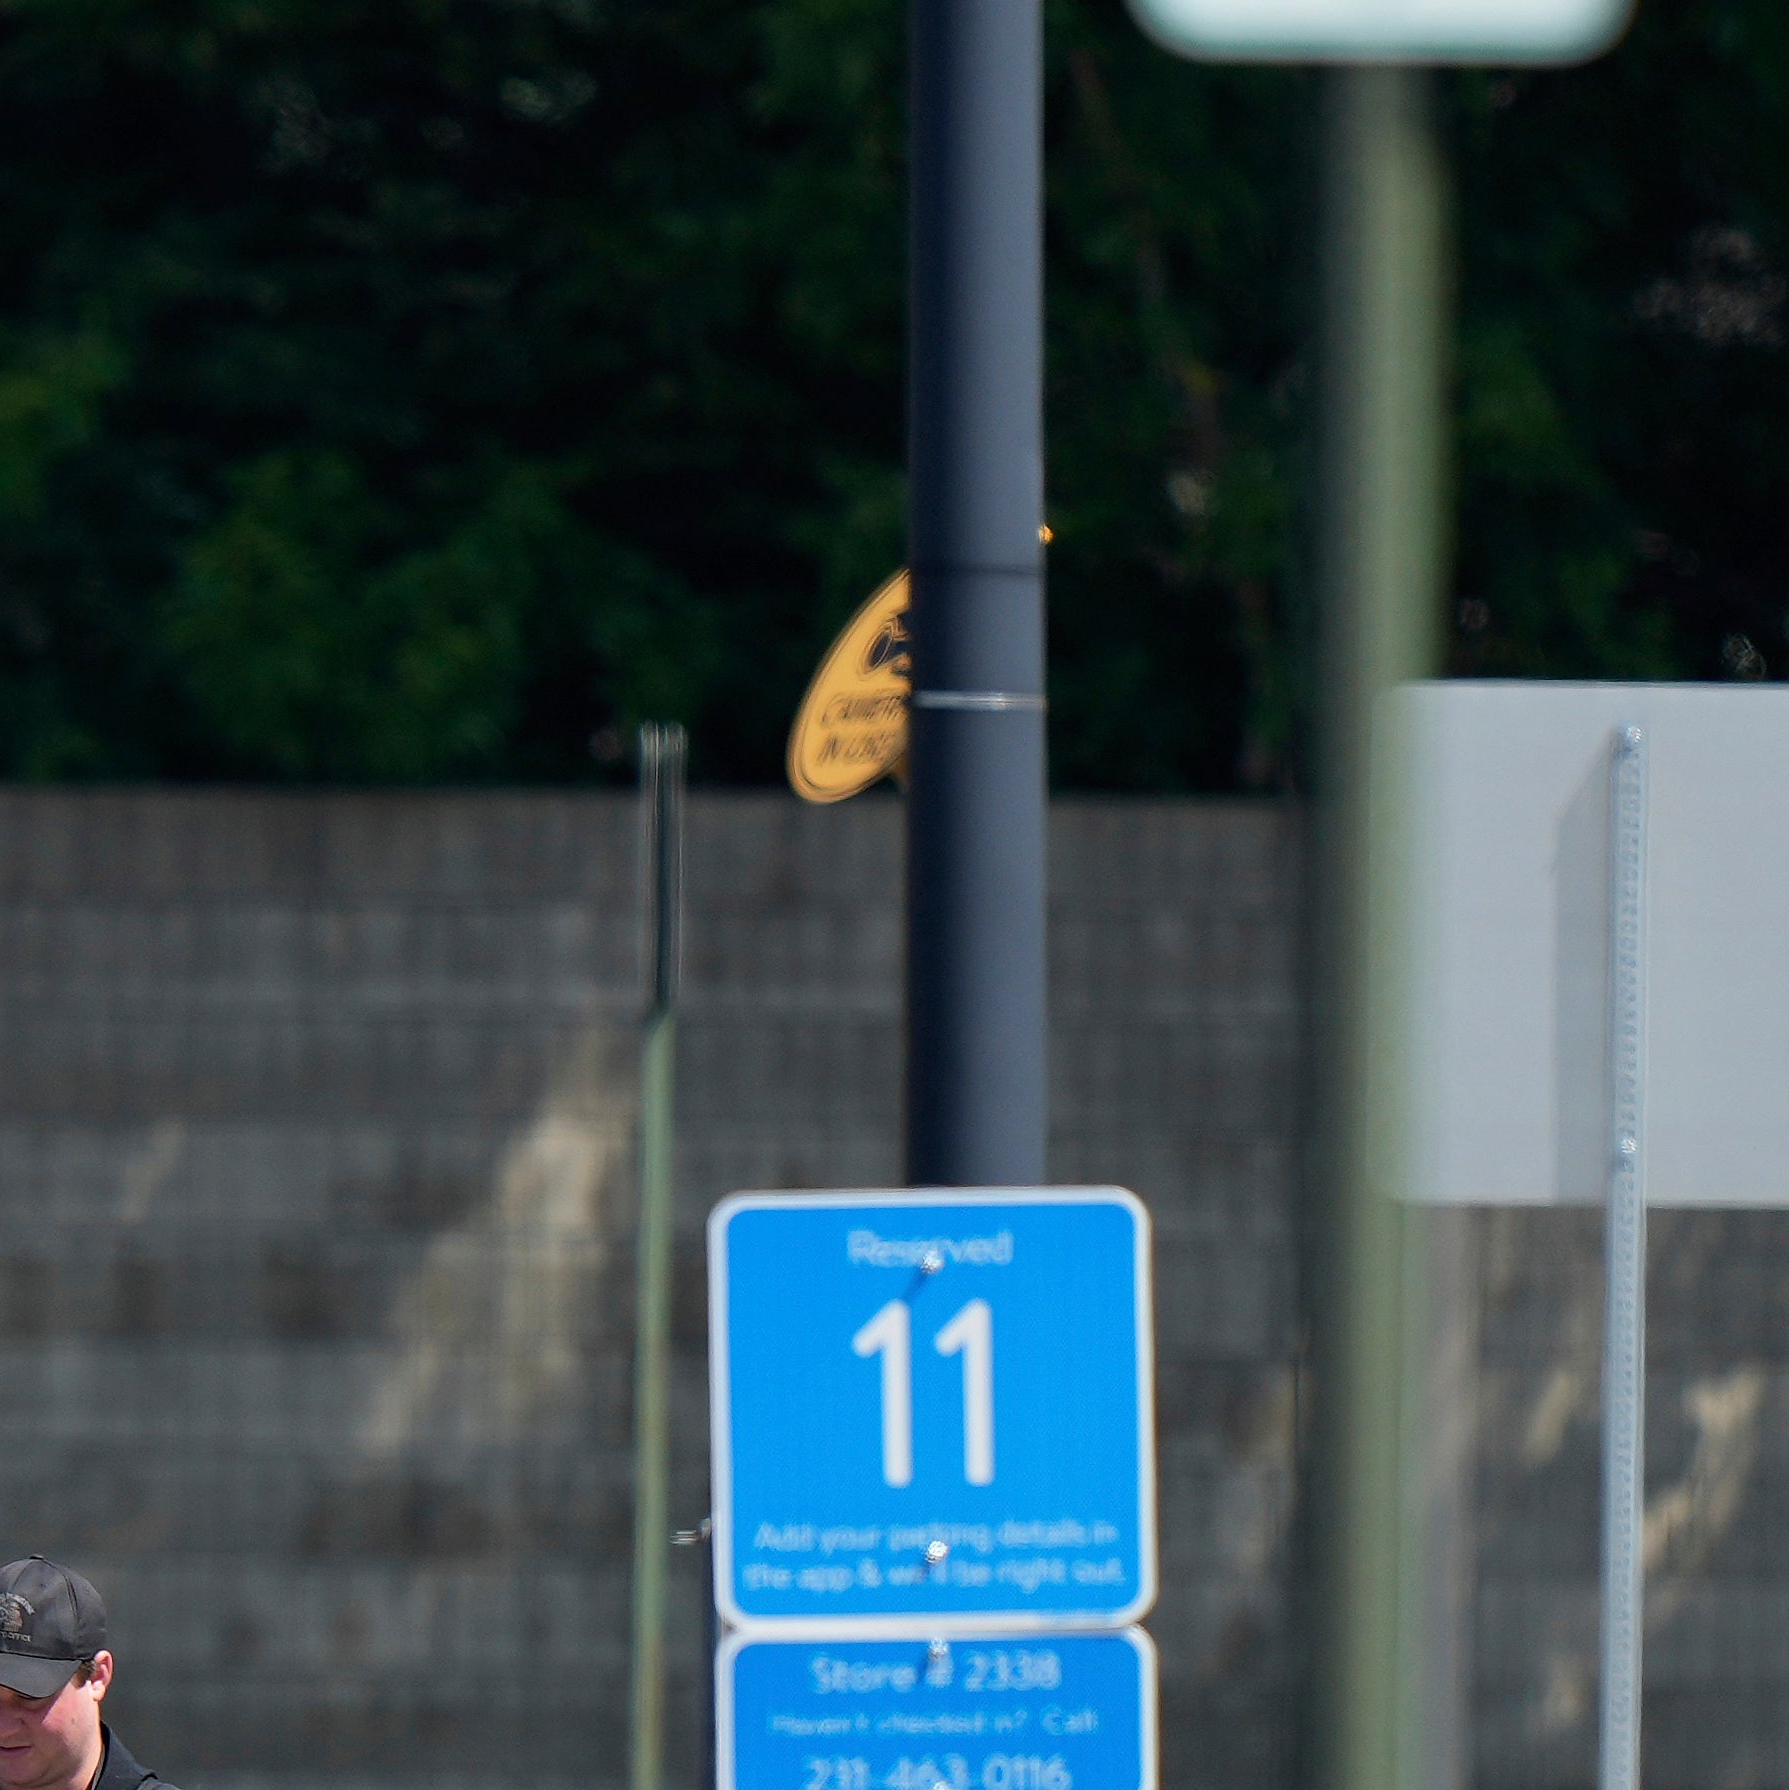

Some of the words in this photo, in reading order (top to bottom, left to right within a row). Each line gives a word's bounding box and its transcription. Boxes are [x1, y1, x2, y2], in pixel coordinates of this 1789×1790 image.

[847, 1229, 1015, 1266] Reserved
[851, 1297, 995, 1489] 11
[811, 1653, 917, 1694] Store
